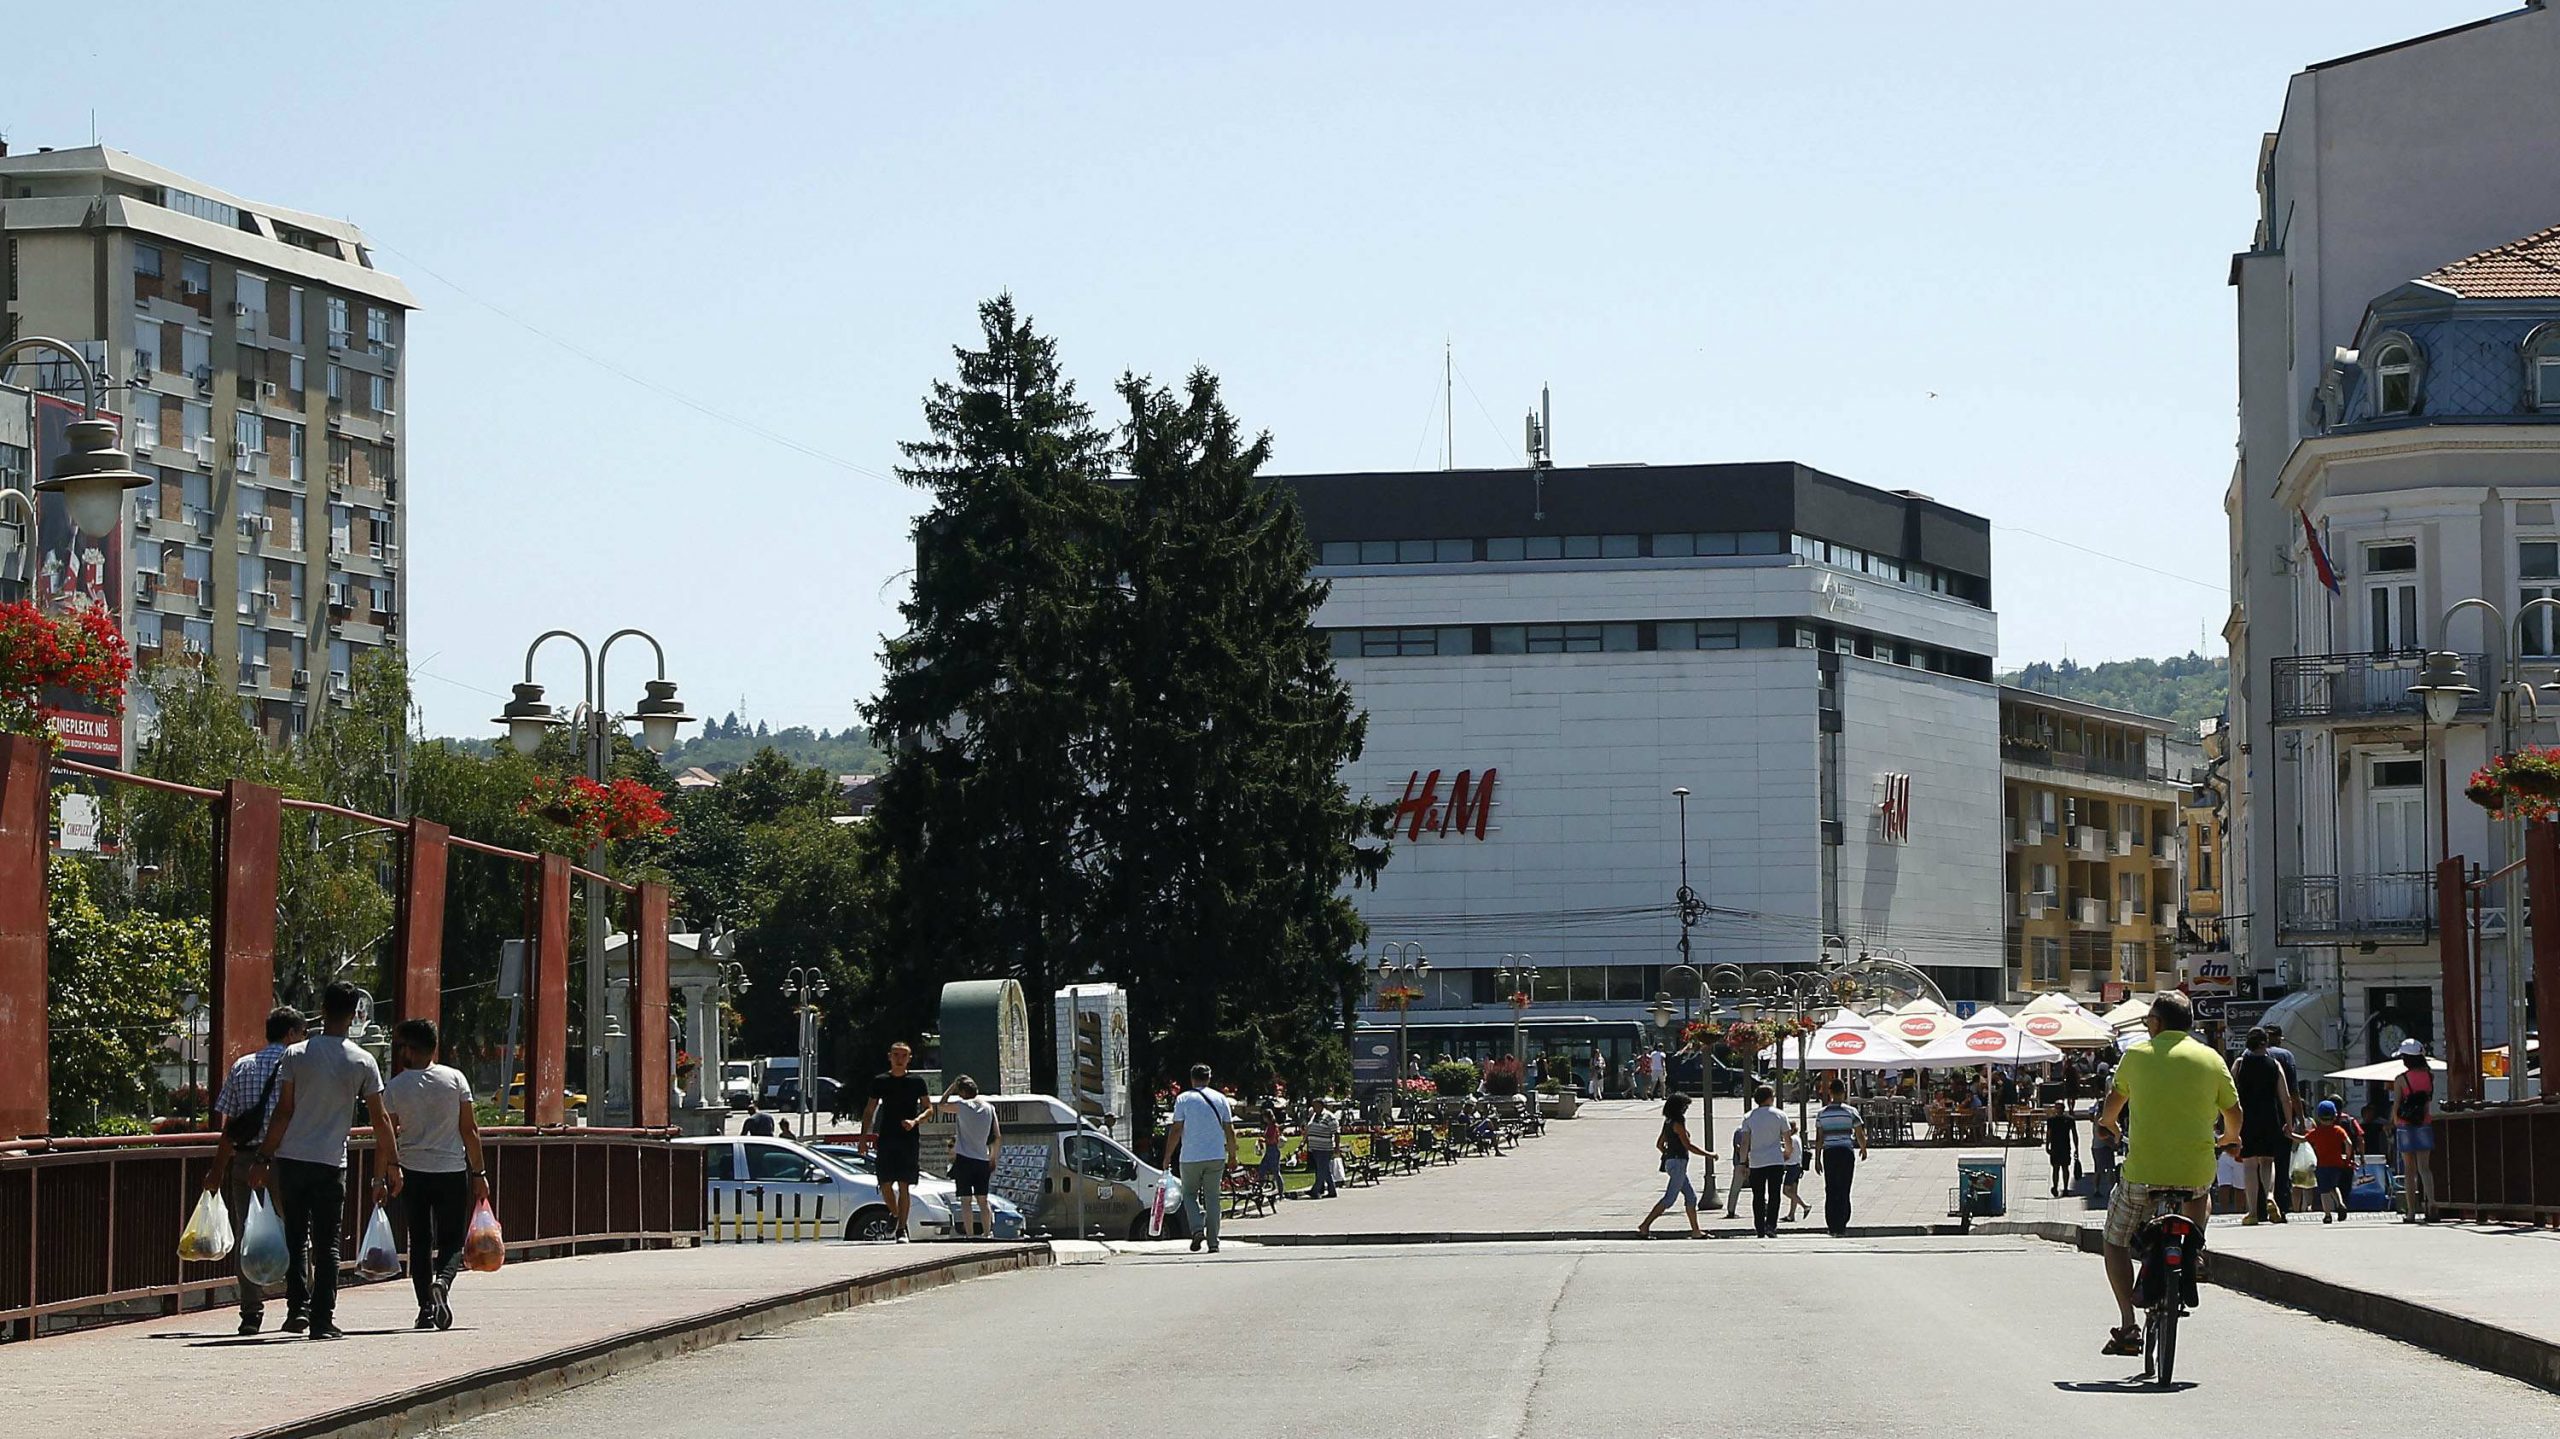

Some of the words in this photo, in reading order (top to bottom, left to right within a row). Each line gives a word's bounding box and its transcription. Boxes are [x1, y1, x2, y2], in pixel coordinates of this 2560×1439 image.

[51, 716, 94, 735] CINEPLEXX
[95, 719, 109, 738] NIŠ
[1387, 768, 1497, 842] H&M
[1878, 771, 1909, 844] H&M
[2200, 960, 2229, 977] dm
[1826, 1040, 1864, 1049] Coca-Cola
[1966, 1037, 2004, 1047] Coca-Cola
